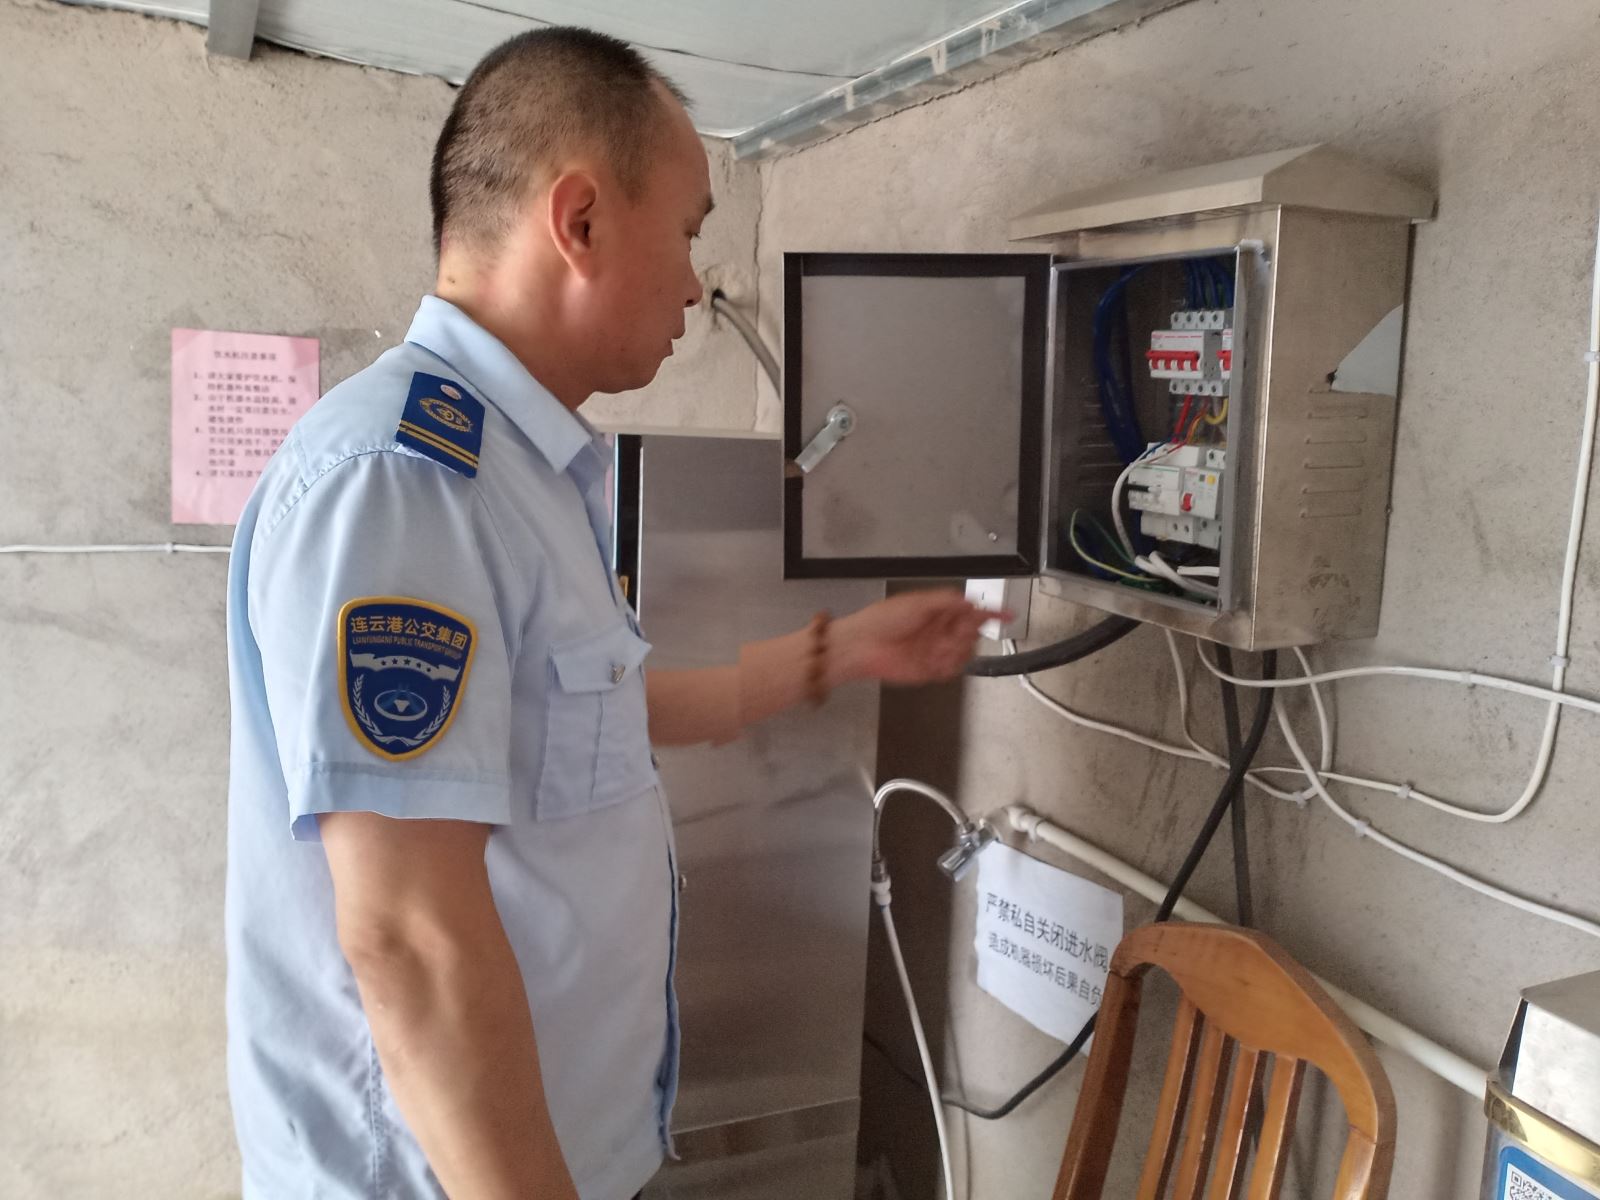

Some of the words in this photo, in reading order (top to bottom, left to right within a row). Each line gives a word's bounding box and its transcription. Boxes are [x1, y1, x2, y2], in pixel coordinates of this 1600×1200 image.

[351, 616, 467, 649] 连云港公交集团
